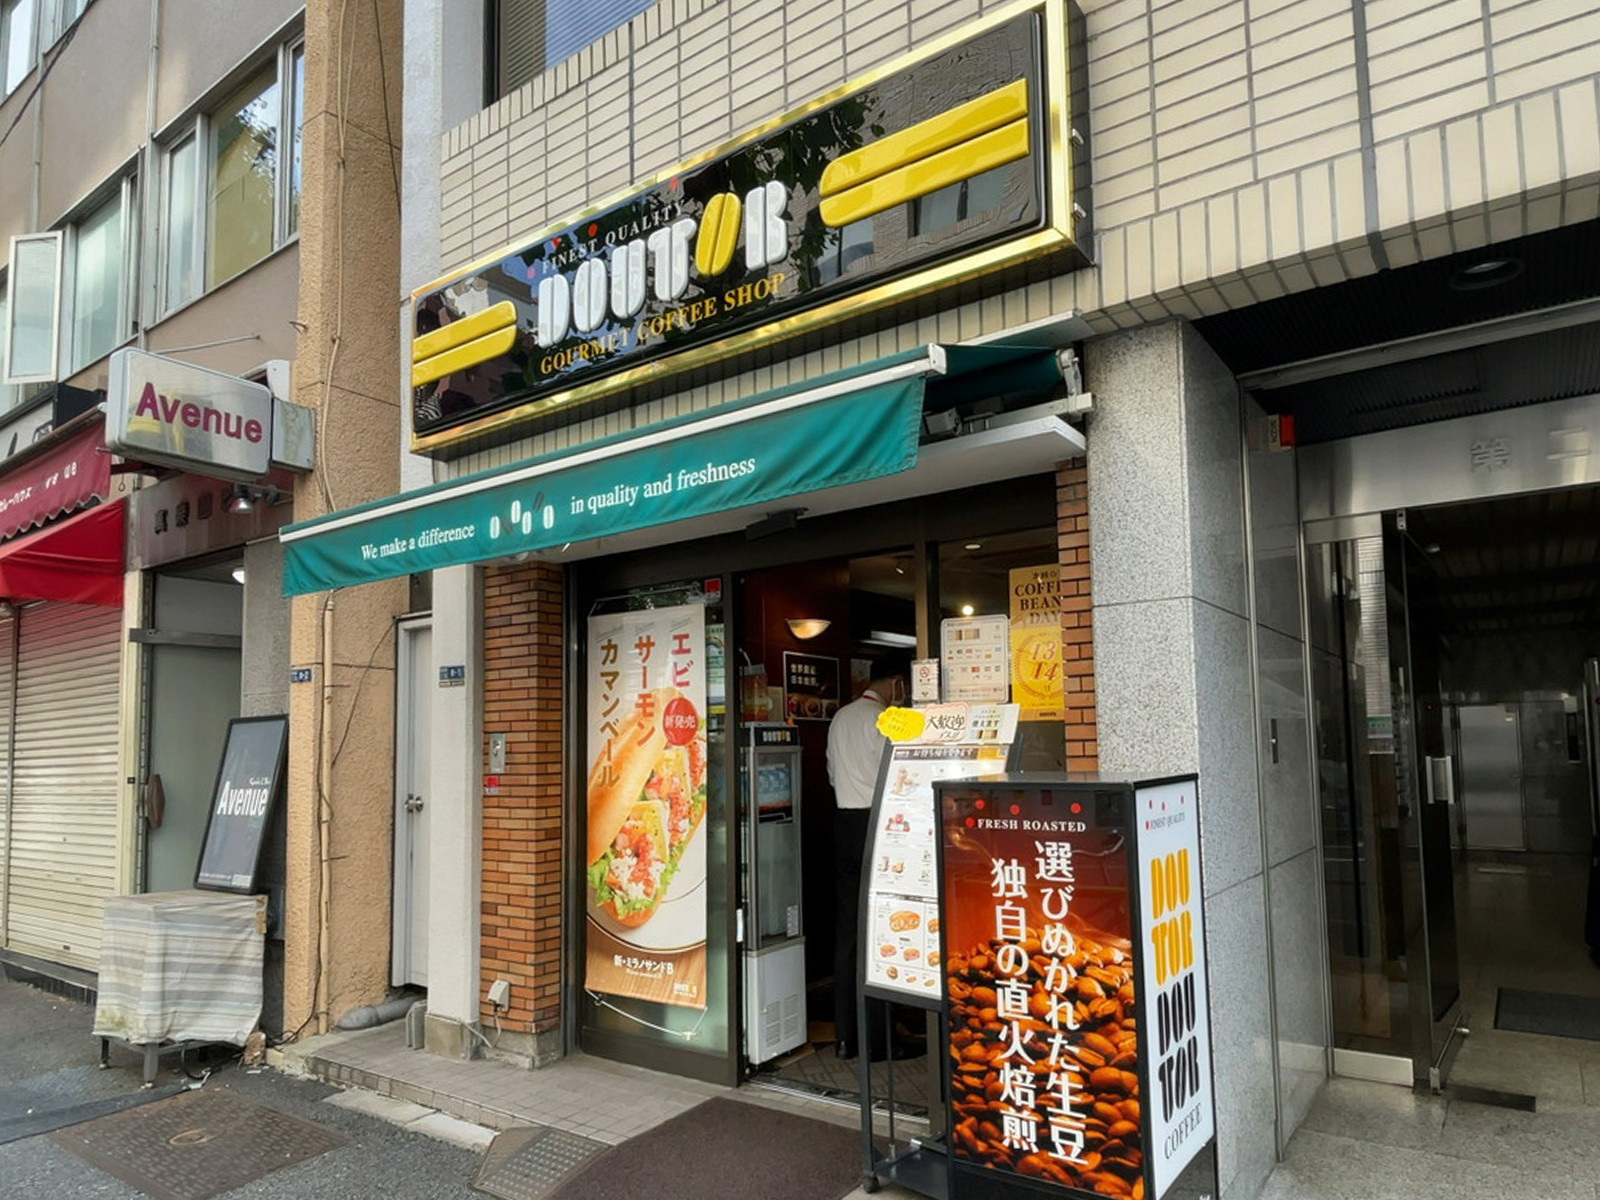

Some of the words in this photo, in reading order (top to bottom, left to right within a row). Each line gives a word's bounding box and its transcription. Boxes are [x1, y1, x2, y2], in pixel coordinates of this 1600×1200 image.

[538, 180, 789, 349] DOUTOR
[541, 237, 599, 276] FINEST
[605, 201, 684, 247] QUALITY
[540, 328, 629, 375] GOURMET
[636, 295, 718, 336] COFFEE
[725, 272, 786, 312] SHOP
[136, 382, 263, 444] Avenue
[571, 496, 584, 515] in
[588, 485, 639, 514] quality
[644, 473, 673, 498] and
[677, 457, 756, 490] freshness
[361, 544, 378, 560] We
[380, 539, 406, 557] make
[409, 539, 416, 551] a
[418, 523, 475, 549] difference
[1020, 596, 1061, 611] BEAN
[1029, 610, 1061, 624] DAY
[671, 633, 694, 687] エビ
[1032, 641, 1056, 661] 13
[1033, 661, 1059, 681] 14
[600, 638, 620, 787] カマンベール
[634, 635, 656, 746] サーモン
[217, 781, 269, 817] Avenue
[977, 818, 1018, 830] FRESH
[1023, 819, 1087, 833] ROASTED
[1150, 848, 1190, 920] DOU
[1151, 910, 1193, 987] TOR
[991, 858, 1038, 1154] 独自の直火焙煎
[1035, 840, 1089, 1165] 選びぬかれた生豆
[1158, 972, 1196, 1057] DOU
[1158, 1035, 1200, 1123] TOR
[1164, 1102, 1203, 1160] COFFEE
